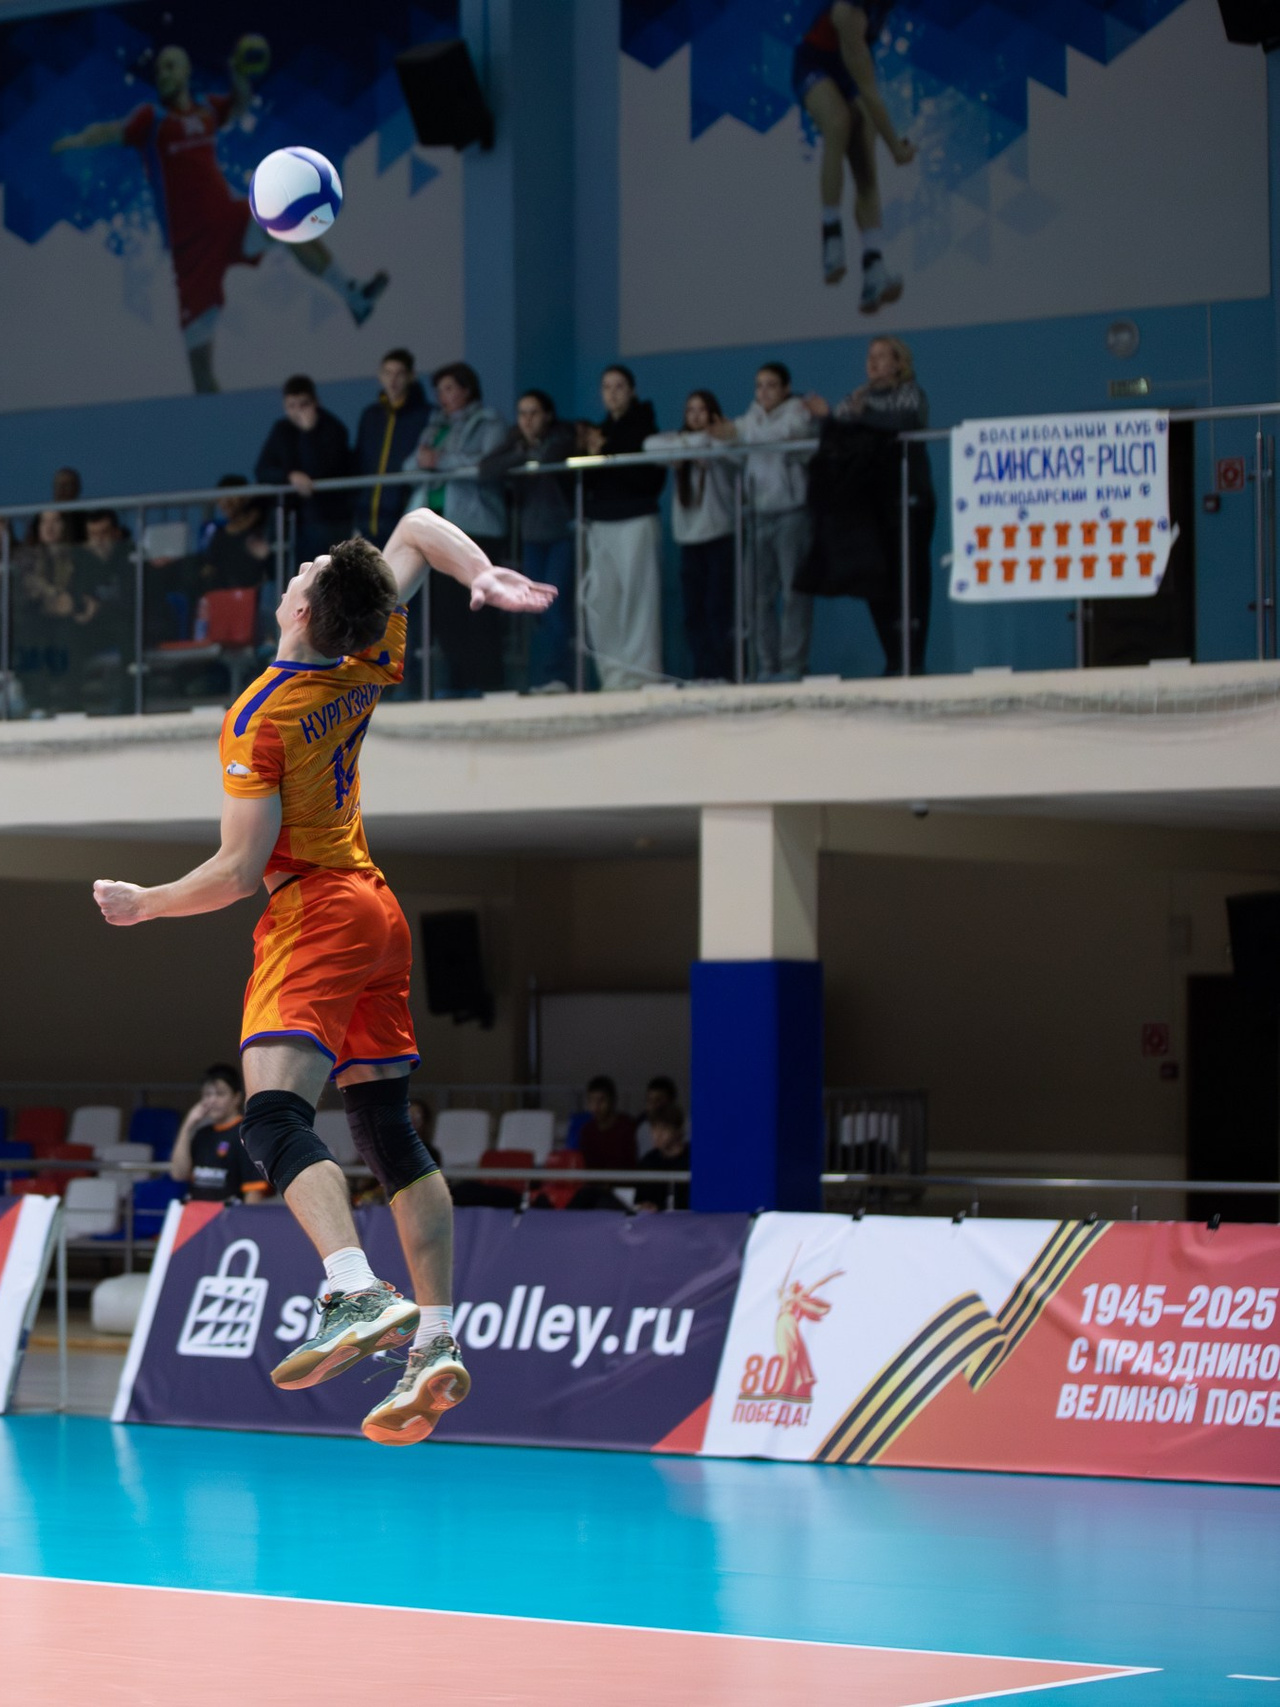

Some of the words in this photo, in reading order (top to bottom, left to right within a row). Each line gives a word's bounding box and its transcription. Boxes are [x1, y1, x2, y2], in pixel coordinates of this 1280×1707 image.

[1115, 419, 1151, 438] КЛУБ
[974, 441, 1156, 483] ДИНСКАЯ-РЦСП
[741, 1354, 784, 1395] 80
[1067, 1337, 1089, 1374] С
[1095, 1338, 1280, 1382] ПРАЗДНИКО
[732, 1402, 811, 1427] ПОБЕДА!
[1056, 1383, 1199, 1424] ВЕЛИКОЙ
